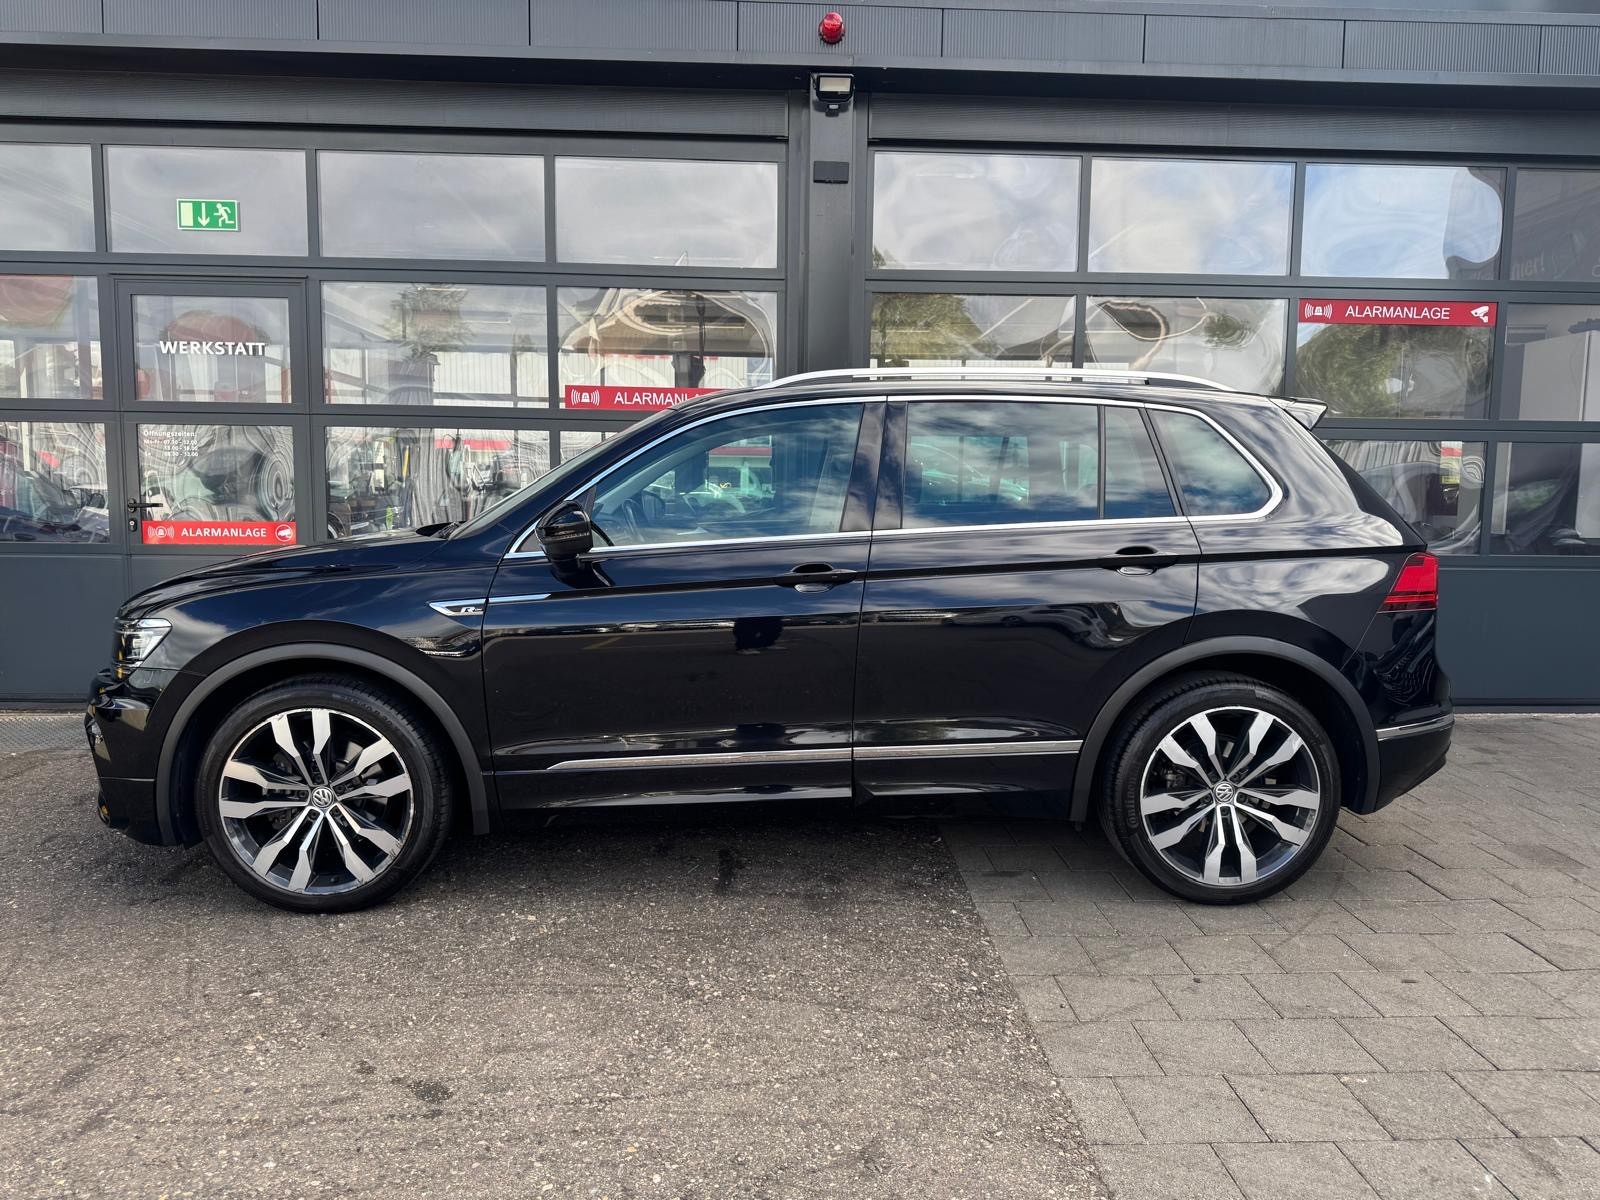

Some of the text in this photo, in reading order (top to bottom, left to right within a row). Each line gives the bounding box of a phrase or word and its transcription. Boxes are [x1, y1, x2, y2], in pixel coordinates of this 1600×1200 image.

[1345, 305, 1451, 319] ALARMANLAGE
[160, 340, 265, 356] WERKSTATT
[614, 391, 700, 406] ALARMANL
[181, 527, 267, 537] ALARMANLAGE
